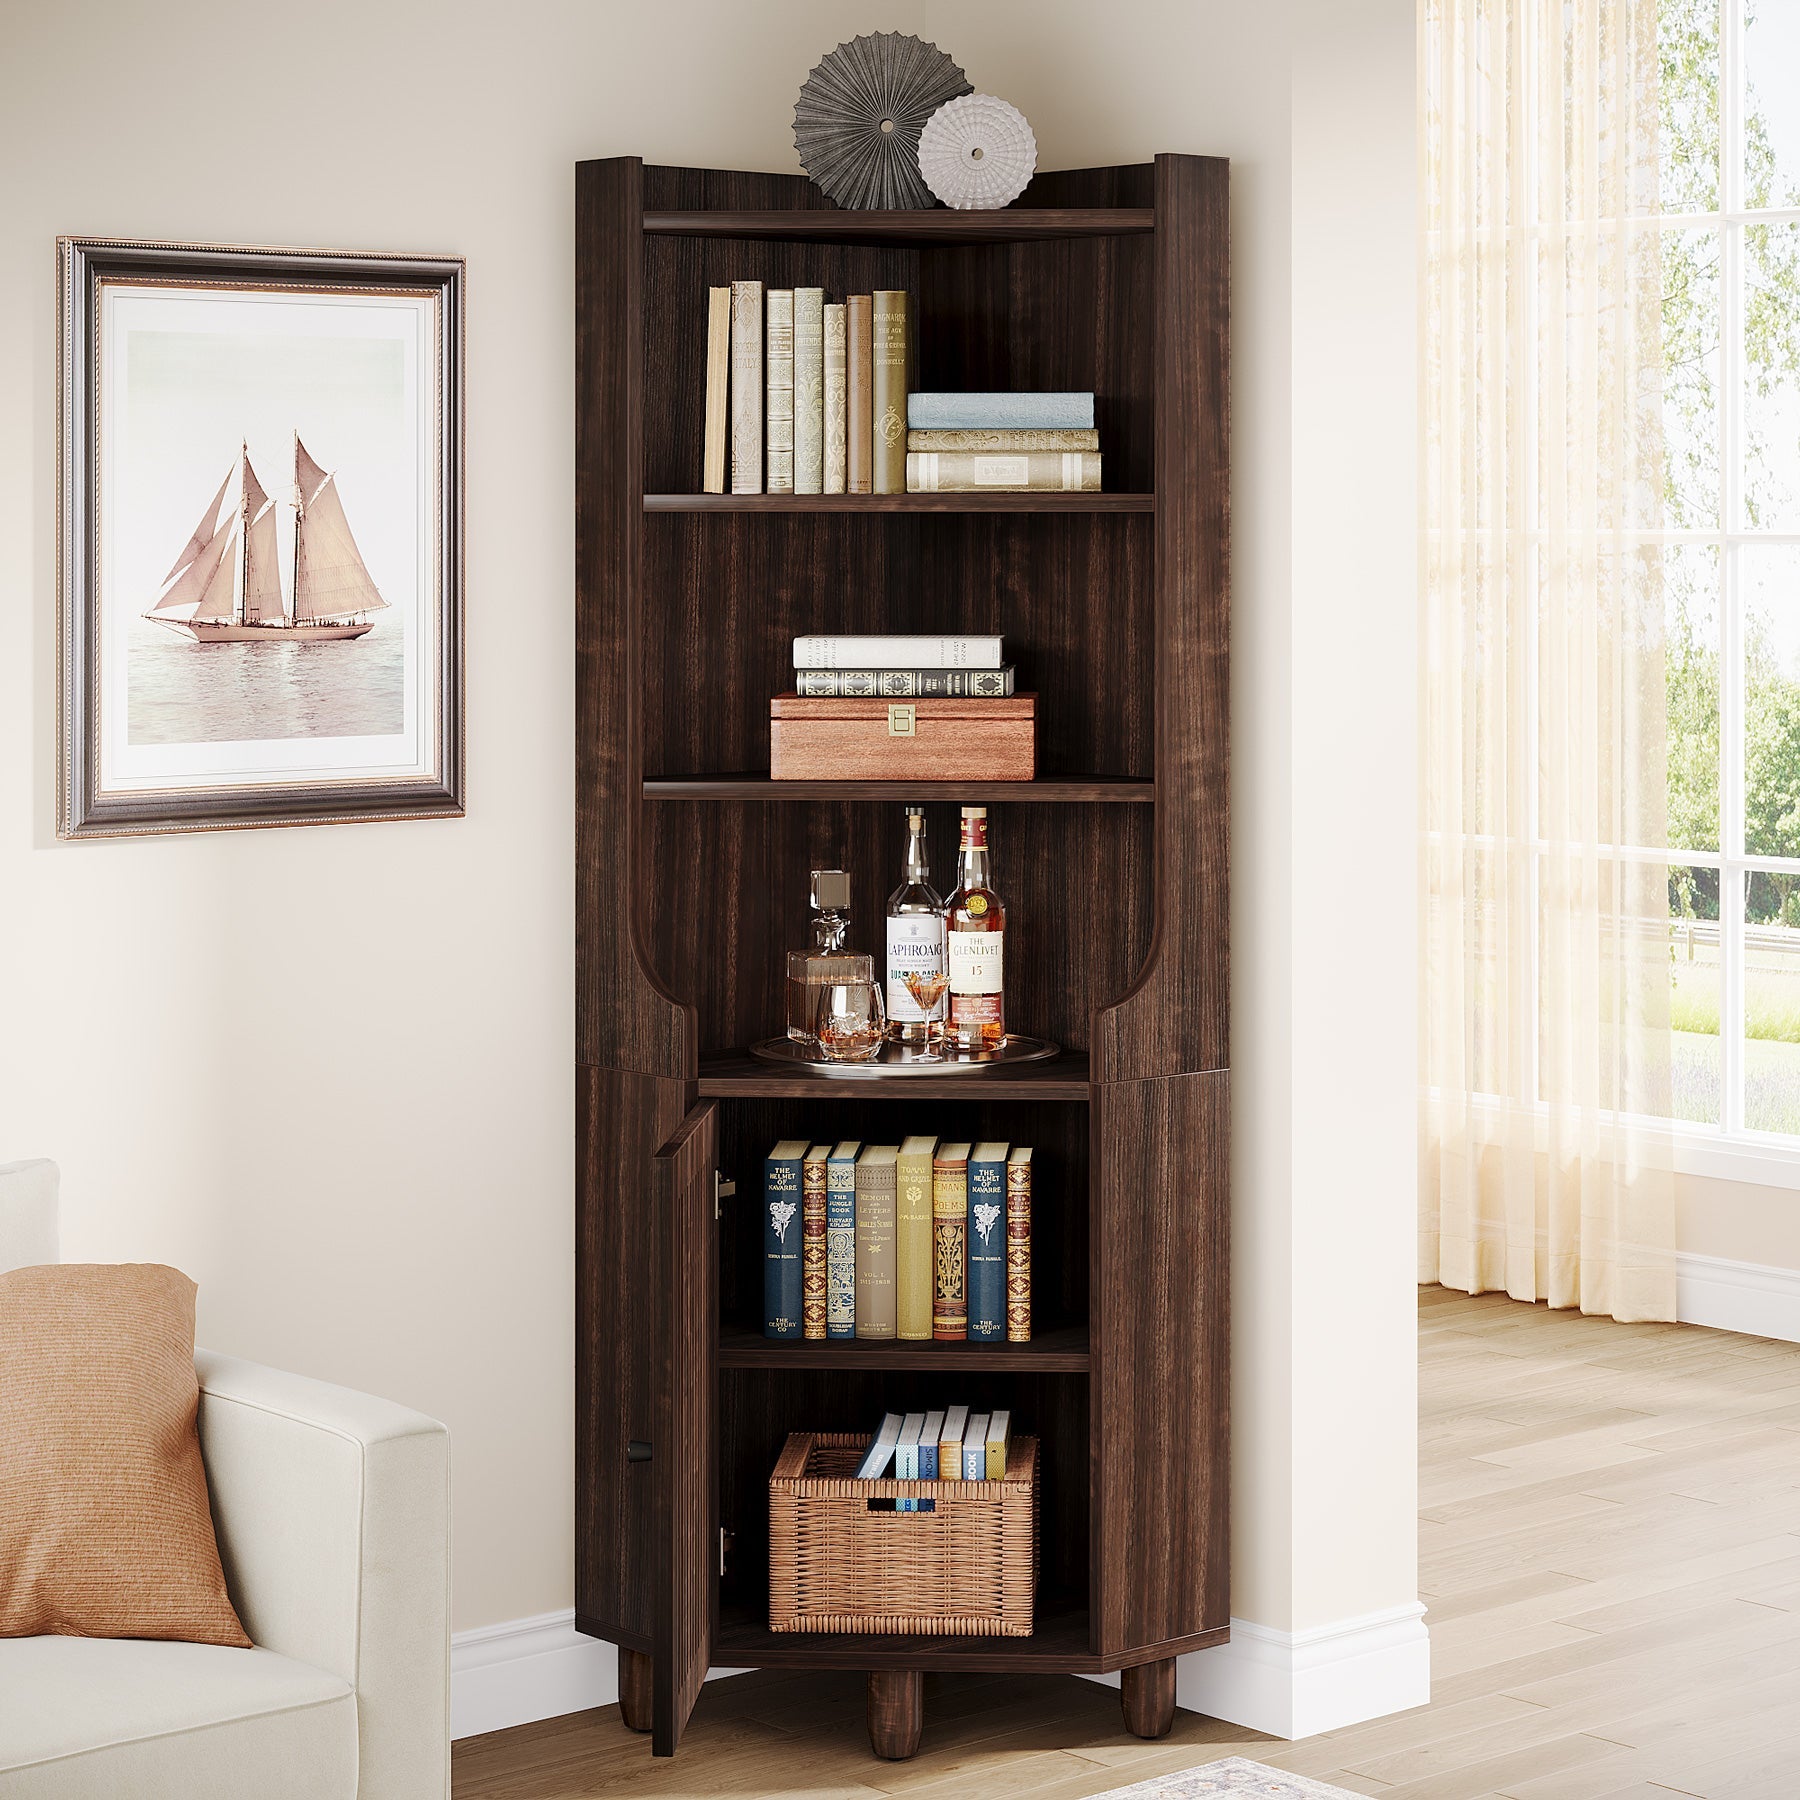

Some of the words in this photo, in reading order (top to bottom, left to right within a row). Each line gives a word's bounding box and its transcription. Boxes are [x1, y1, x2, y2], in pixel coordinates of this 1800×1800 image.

[889, 944, 942, 956] LAPHROAIG
[954, 945, 999, 956] GLENLIVET
[972, 966, 983, 976] 15
[934, 1200, 965, 1209] POEMS
[926, 1448, 934, 1477] SIMON
